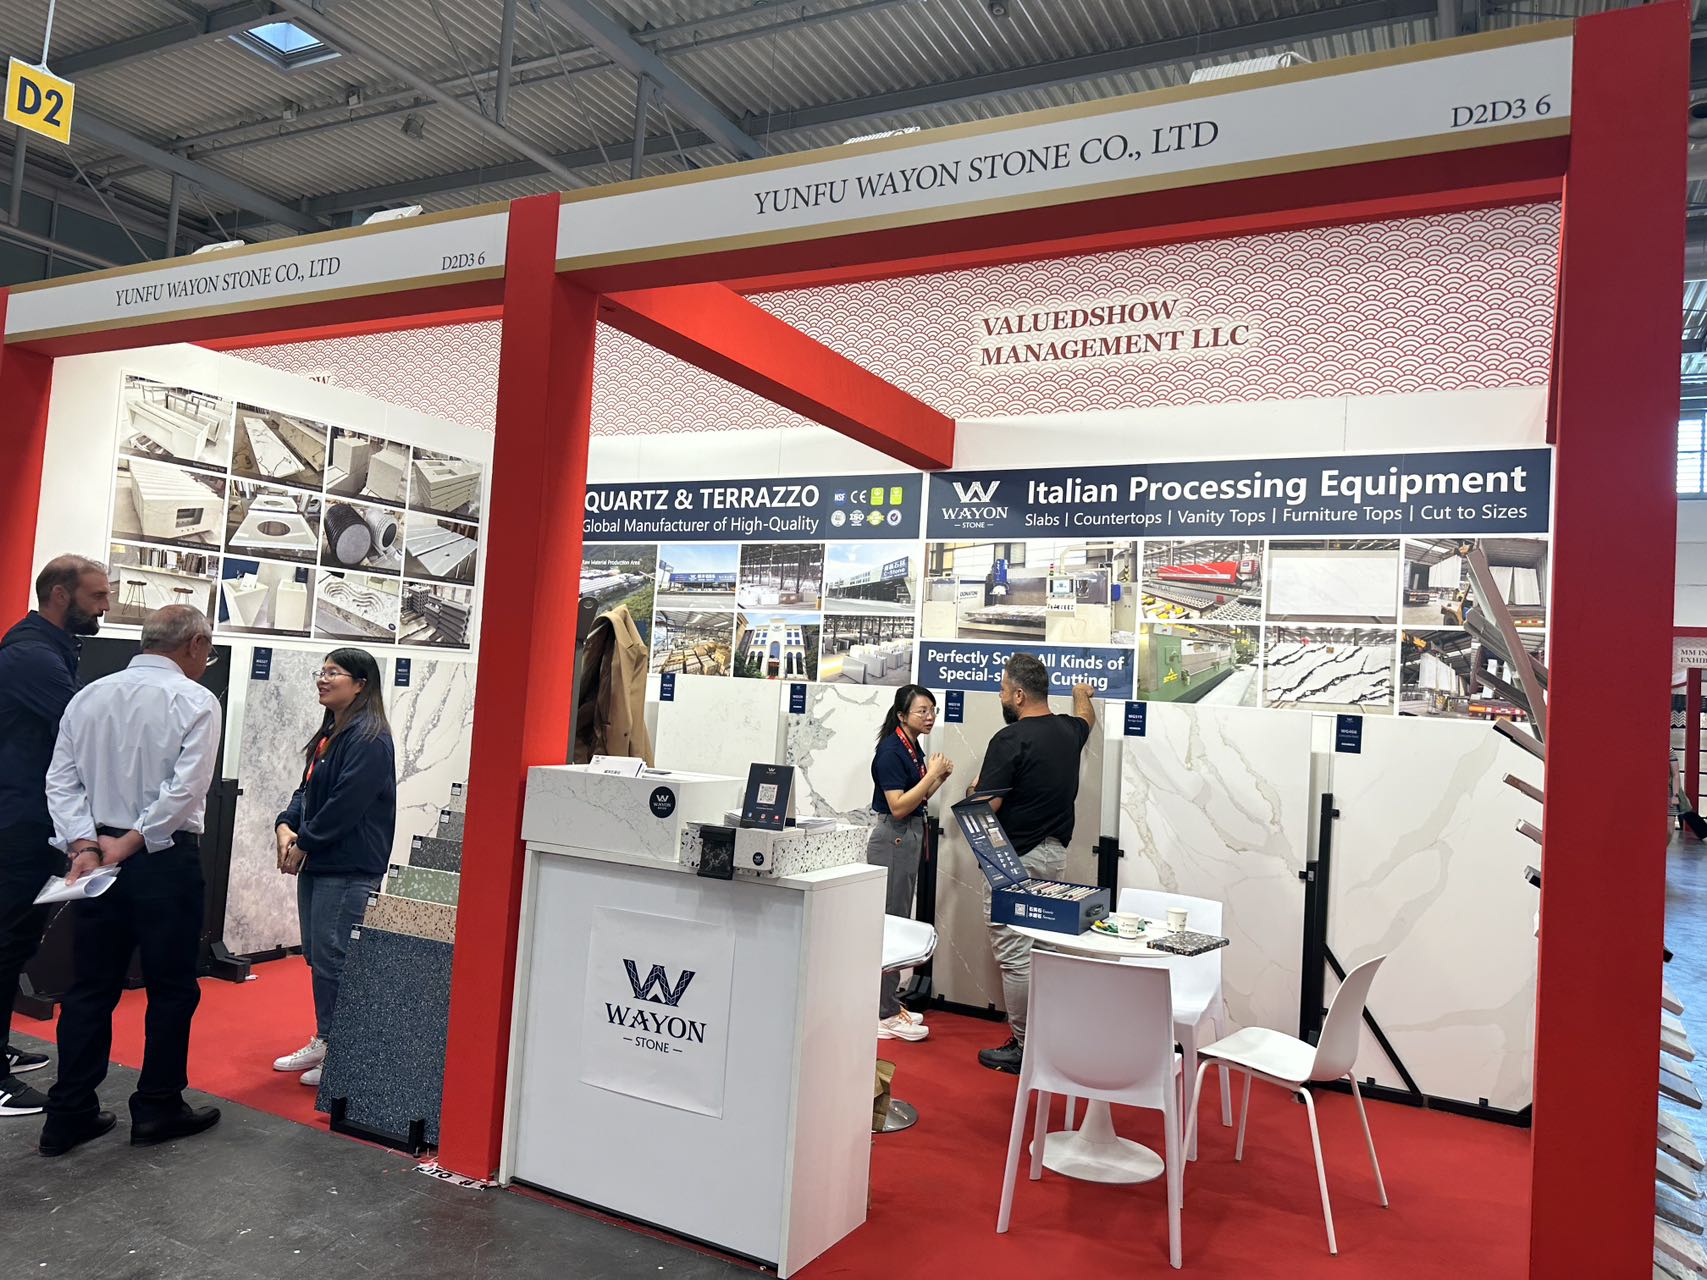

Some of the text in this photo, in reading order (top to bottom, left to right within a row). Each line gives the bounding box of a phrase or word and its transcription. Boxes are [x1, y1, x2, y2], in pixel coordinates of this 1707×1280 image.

[17, 75, 64, 128] D2
[1450, 93, 1551, 128] D2D3 6
[754, 120, 1220, 215] YUNFU WAYON STONE CO., LTD
[441, 251, 486, 271] D2D3 6
[116, 256, 341, 307] YUNFU WAYON STONE CO., LTD
[981, 299, 1178, 336] VALUEDSHOW
[980, 324, 1250, 366] MANAGEMENT LLC
[584, 484, 820, 513] QUARTZ & TERRAZZO
[1028, 465, 1527, 506] Italian Processing Equipment
[582, 514, 819, 535] Global Manufacturer of High-Quality
[942, 506, 1008, 520] WAYON
[962, 521, 985, 529] STONE
[1025, 504, 1527, 528] Slabs Countertops Vanity Tops Furniture Tops Cut to Sizes
[927, 649, 989, 668] Perfectly
[1037, 653, 1056, 668] All
[1060, 654, 1103, 669] Kinds
[1107, 656, 1125, 671] of
[1051, 671, 1108, 691] Cutting
[605, 1001, 707, 1044] WAYON
[635, 1036, 669, 1053] STONE
